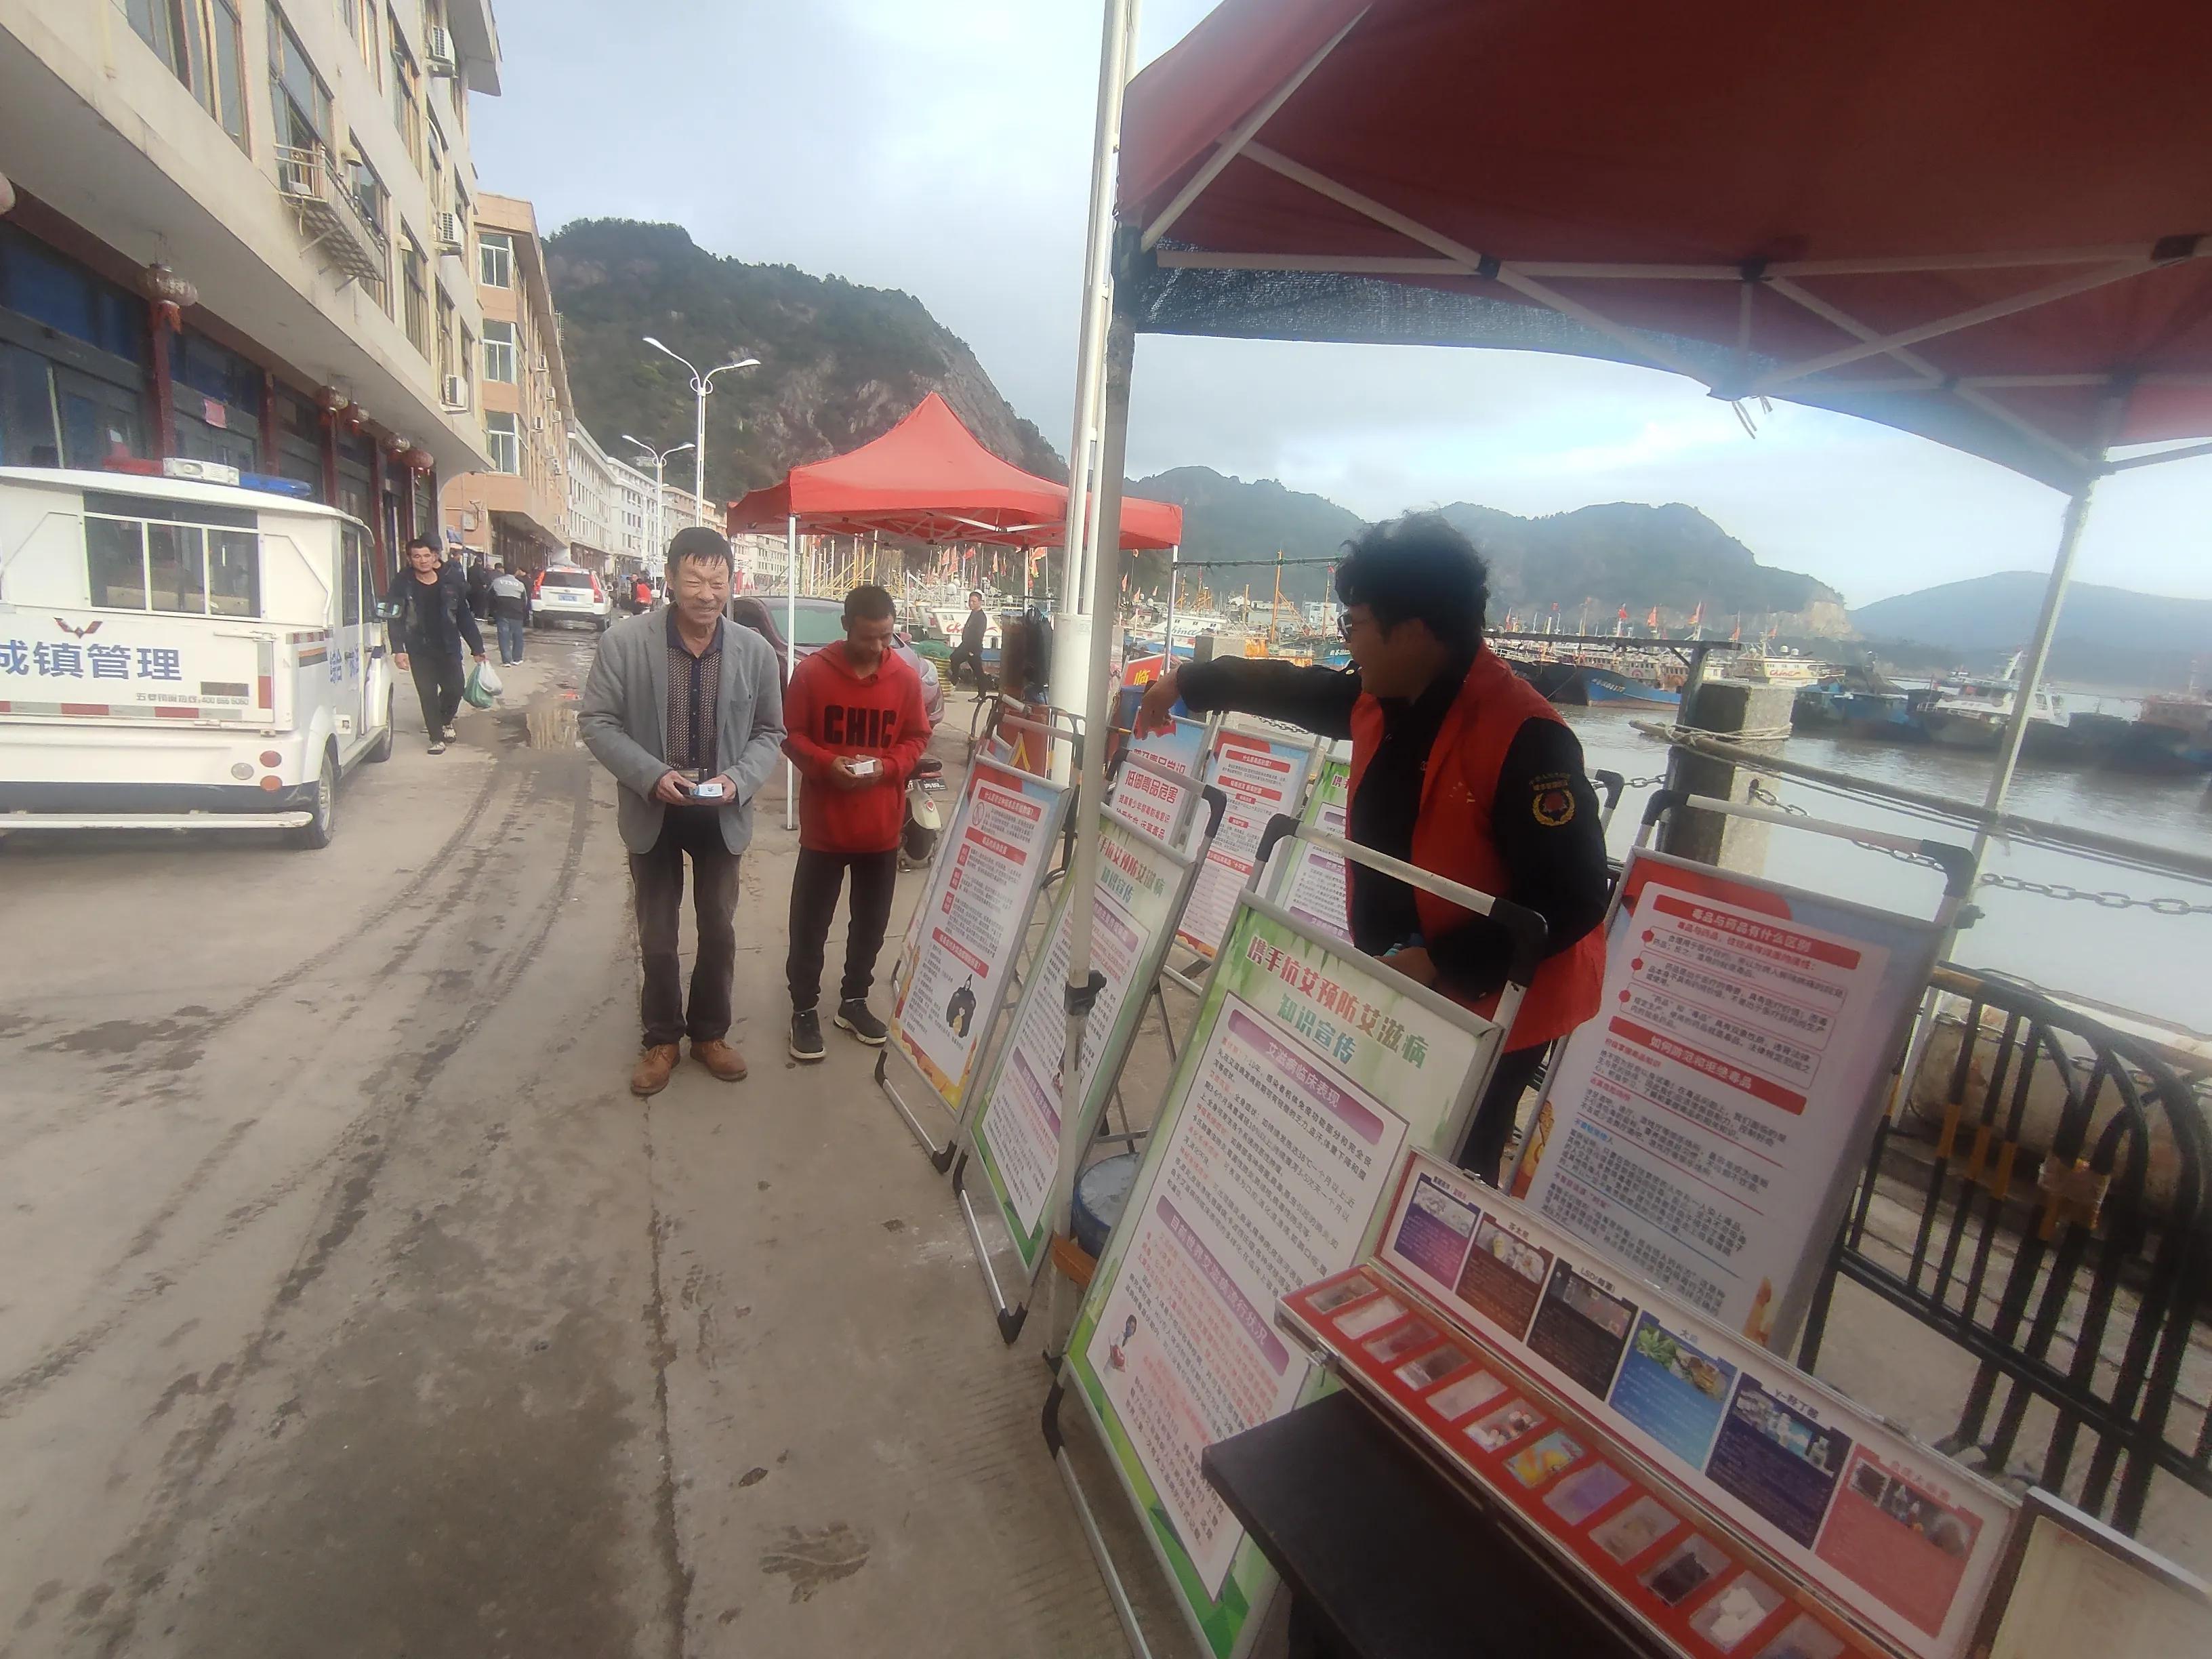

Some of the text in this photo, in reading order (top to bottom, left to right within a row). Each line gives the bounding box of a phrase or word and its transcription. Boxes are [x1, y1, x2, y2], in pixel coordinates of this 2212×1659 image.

[824, 705, 897, 749] CHIC
[1124, 769, 1179, 804] 抵御毒品危害
[1098, 834, 1166, 899] 手抗艾预防艾滋病
[1100, 865, 1134, 903] 知识宣传
[1689, 907, 1814, 954] 毒品与药品有什么区别
[1245, 935, 1430, 1070] 携手抗艾预防艾滋病
[1275, 991, 1359, 1067] 知识宣传
[1265, 1040, 1342, 1109] 艾滋病临床表现
[1647, 1034, 1755, 1090] 如何防范和拒绝毒品
[1170, 1213, 1269, 1347] 目前世界艾滋病流行状况
